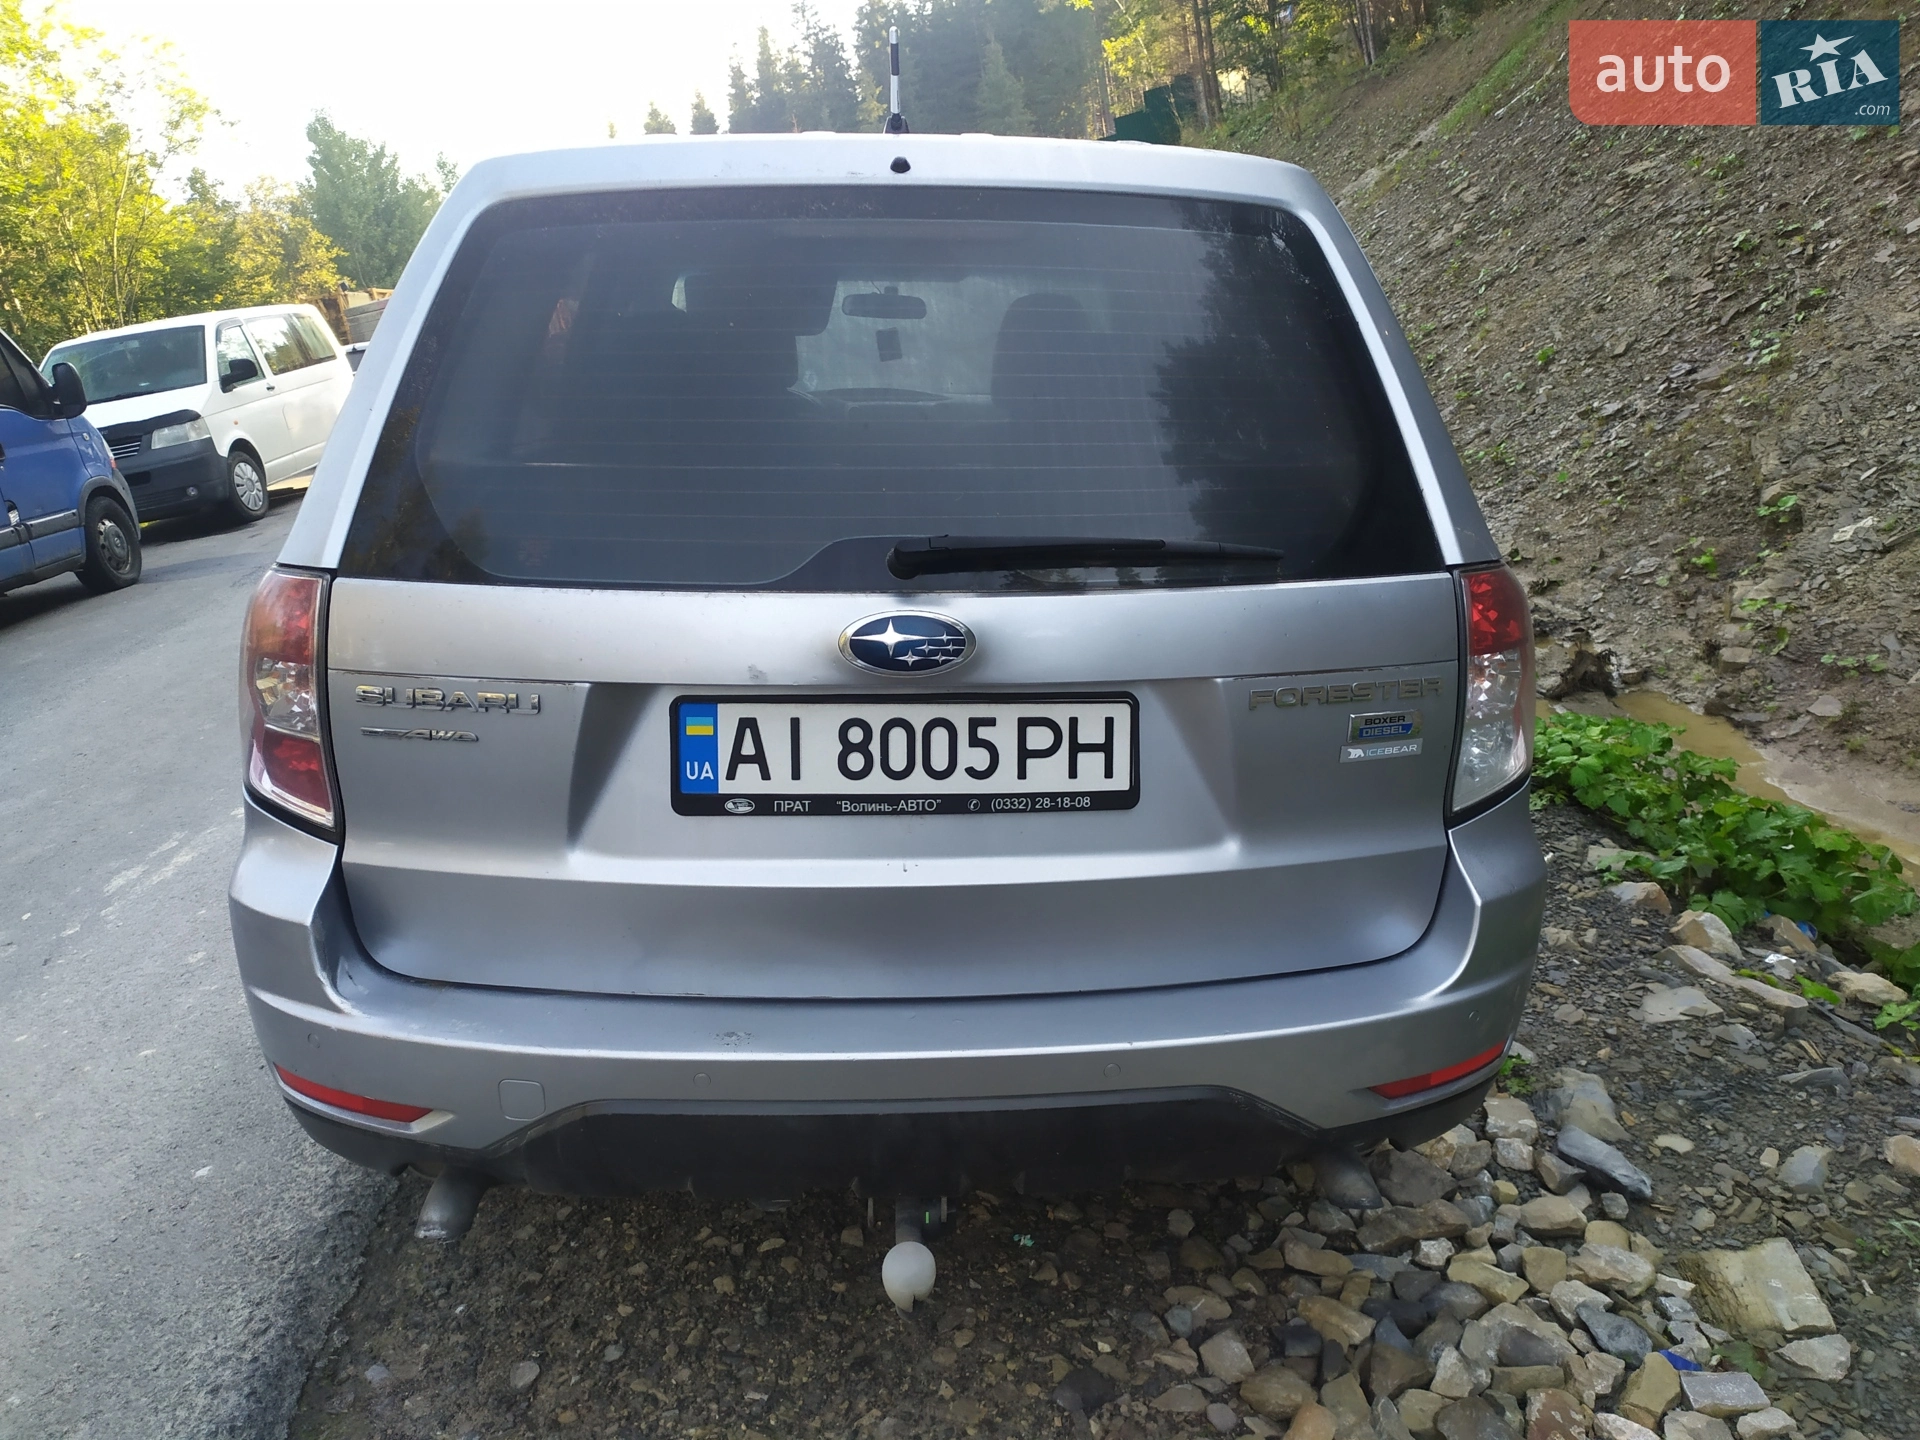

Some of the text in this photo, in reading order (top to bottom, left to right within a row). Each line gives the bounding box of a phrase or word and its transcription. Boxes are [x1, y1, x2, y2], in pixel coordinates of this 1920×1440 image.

[355, 684, 542, 715] SUBARU
[1250, 677, 1443, 711] FORESTER
[1364, 714, 1406, 726] BOXER
[400, 728, 480, 742] AWD
[1362, 725, 1407, 737] DIESEL
[1366, 744, 1418, 756] ICEBEAR
[686, 761, 715, 780] UA
[774, 800, 812, 813] ПРАТ
[990, 796, 1032, 811] (0332)
[1035, 795, 1092, 809] 28-18-08
